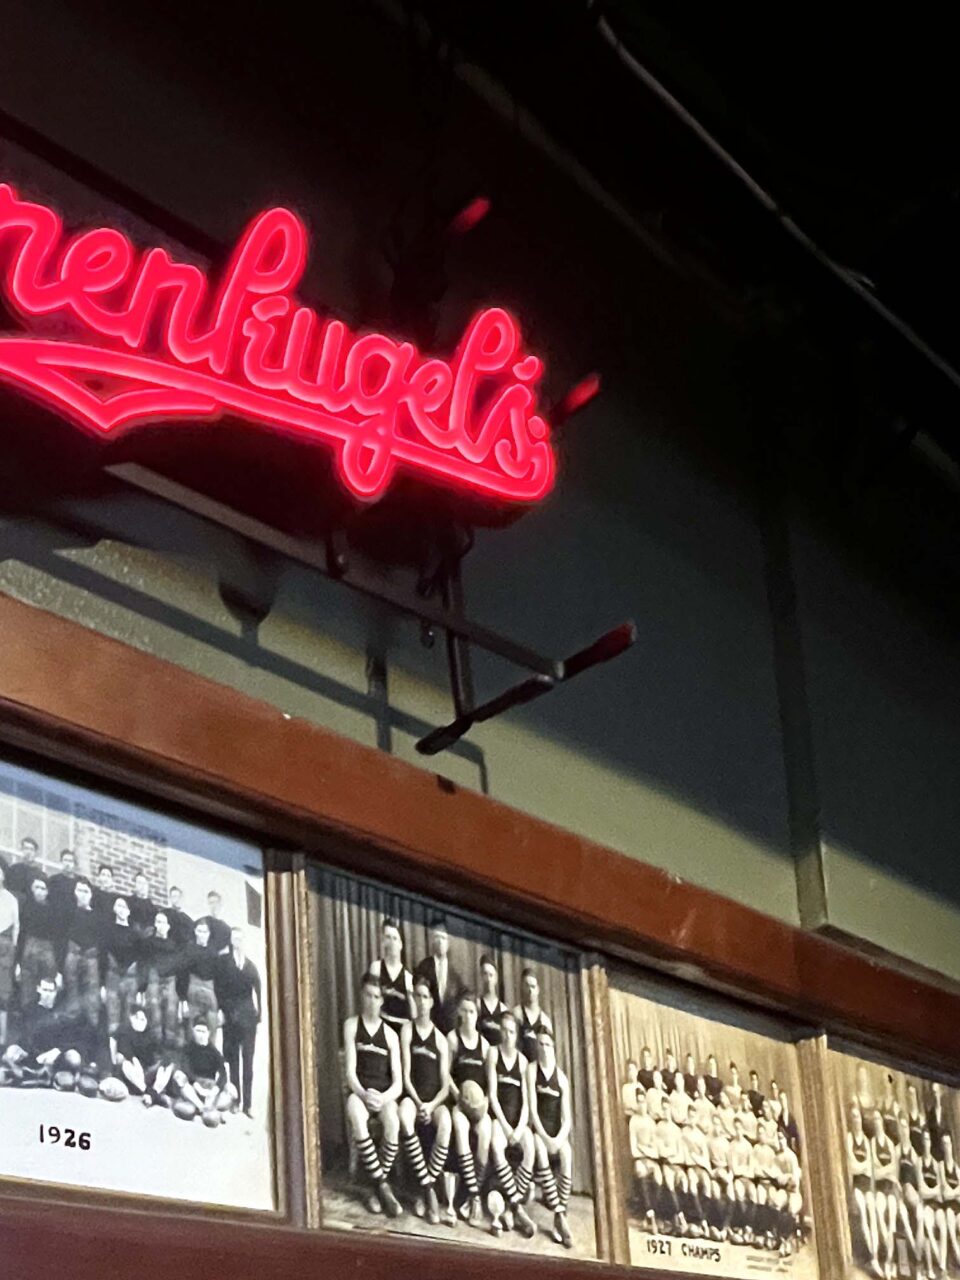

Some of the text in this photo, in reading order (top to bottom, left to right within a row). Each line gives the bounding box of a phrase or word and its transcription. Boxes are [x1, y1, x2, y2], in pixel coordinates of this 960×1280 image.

[40, 1124, 91, 1150] 1926
[647, 1239, 721, 1262] 1927 CHAMPS
